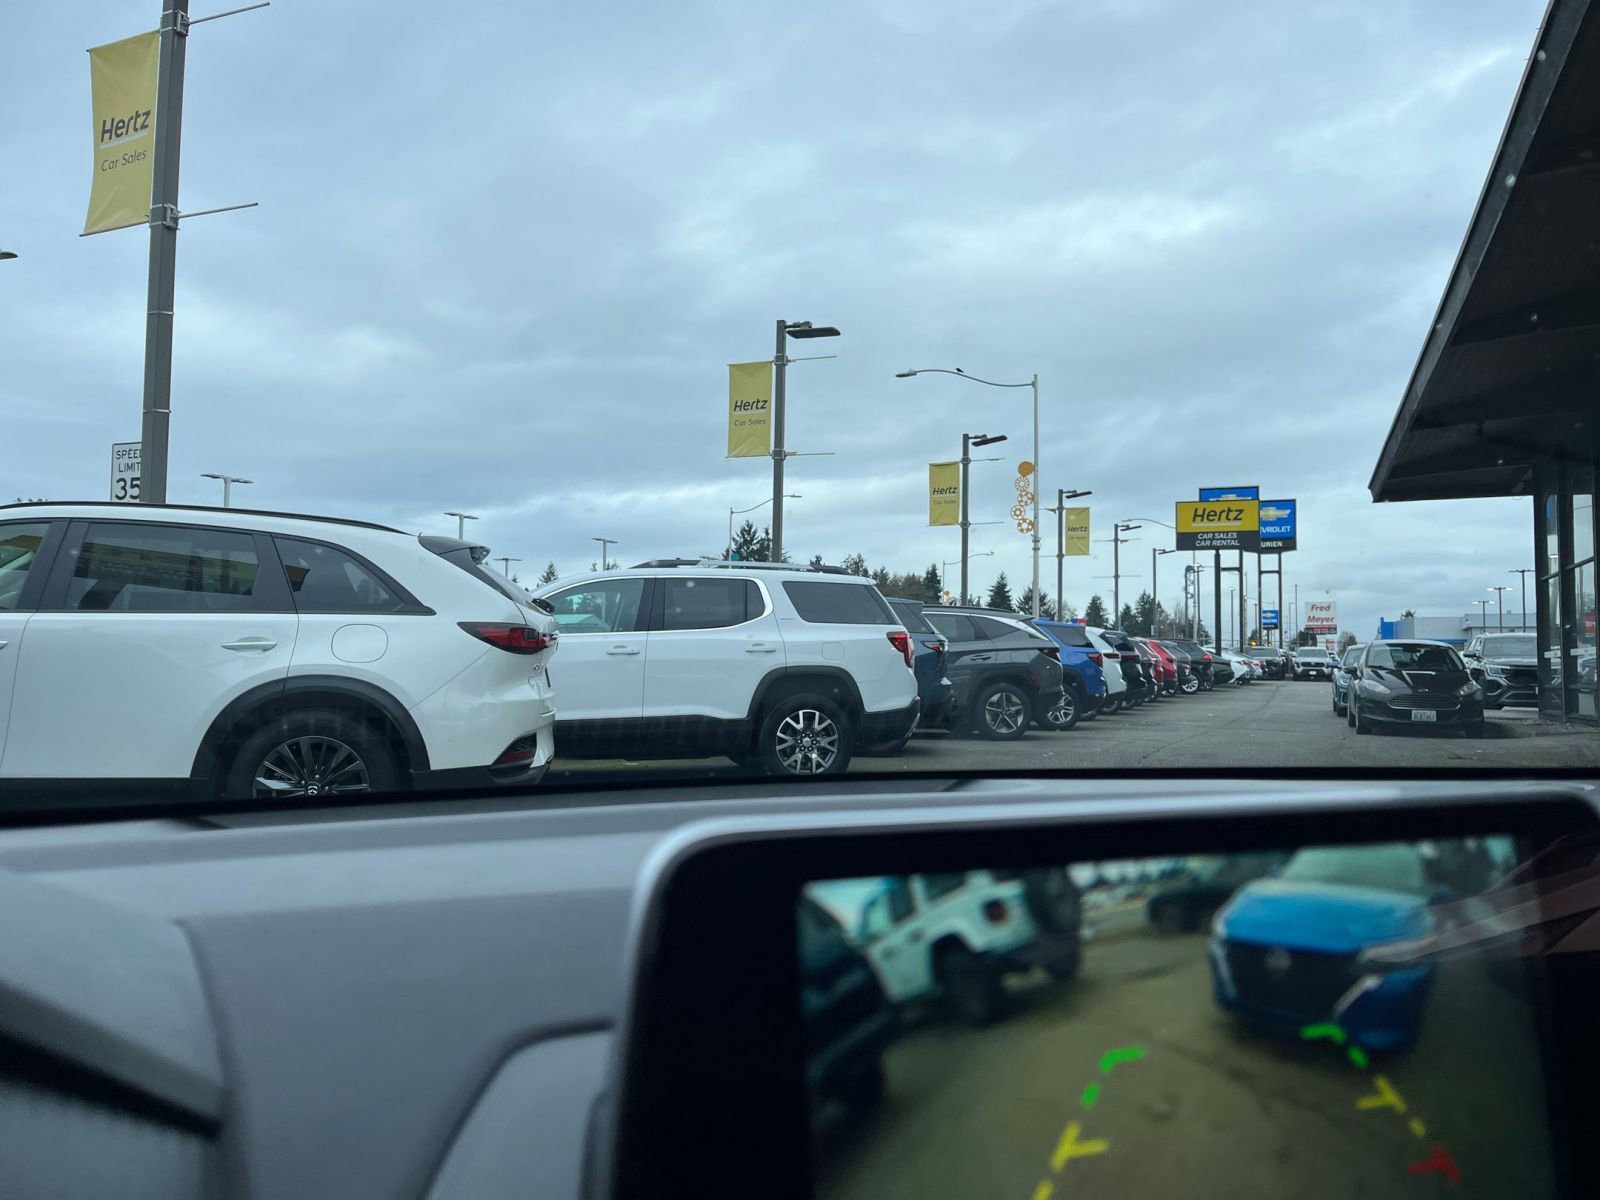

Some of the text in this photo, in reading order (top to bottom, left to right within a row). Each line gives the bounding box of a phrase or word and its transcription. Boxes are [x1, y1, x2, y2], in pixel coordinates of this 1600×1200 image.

[101, 109, 152, 143] Hertz
[101, 150, 147, 172] Car Sales
[733, 399, 769, 412] Hertz
[118, 462, 141, 473] LIMIT
[115, 477, 141, 501] 35
[932, 486, 958, 495] Hertz
[1191, 507, 1245, 523] Hertz
[1260, 525, 1291, 533] VROLET
[1211, 539, 1240, 547] RENTAL
[1311, 604, 1331, 612] Fred
[1307, 615, 1335, 624] Meyer
